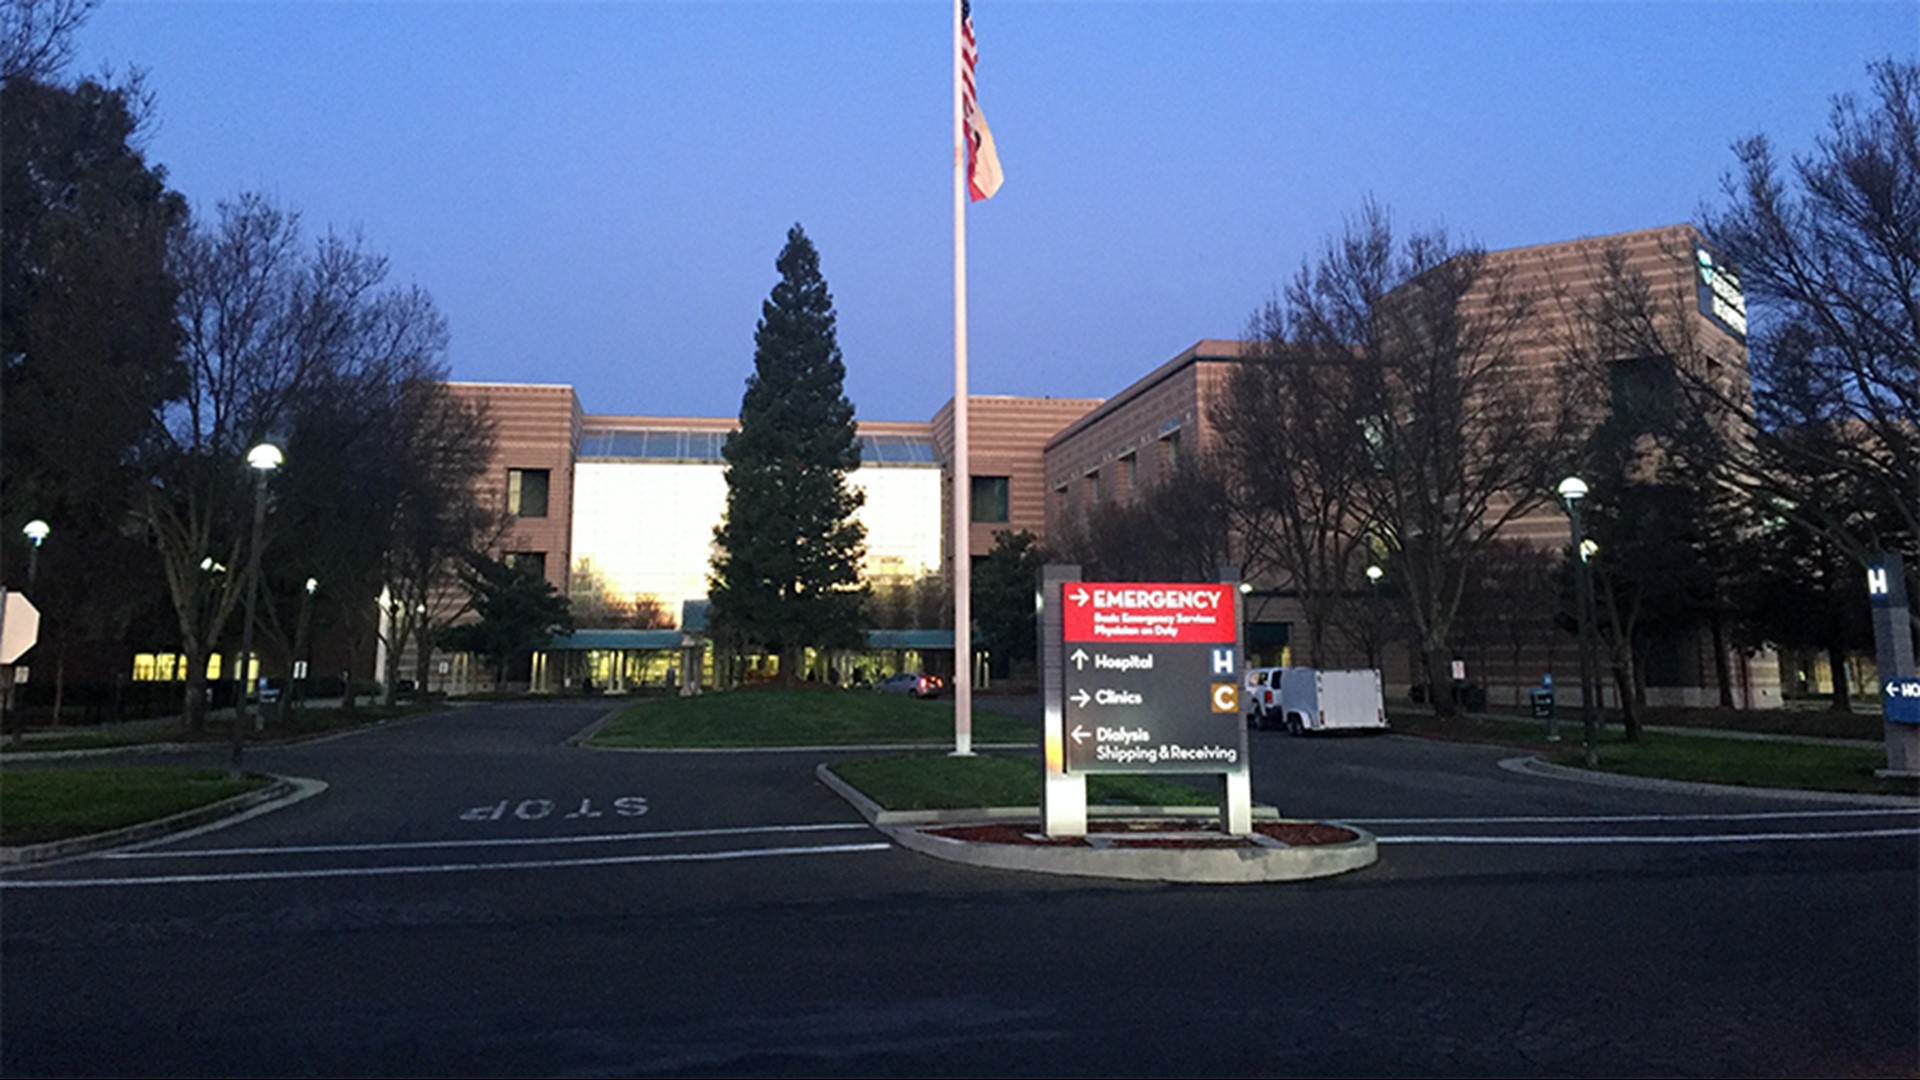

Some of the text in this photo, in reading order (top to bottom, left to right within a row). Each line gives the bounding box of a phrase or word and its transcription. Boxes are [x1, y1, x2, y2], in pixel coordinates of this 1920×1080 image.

[1868, 568, 1888, 594] H
[1093, 590, 1221, 608] EMERGENCY
[1121, 612, 1174, 625] Emergency
[1176, 613, 1216, 624] Services
[1094, 625, 1139, 637] Physician
[1155, 625, 1178, 637] Duty
[1095, 653, 1153, 671] Hospital
[1213, 650, 1234, 674] H
[1095, 689, 1143, 704] Clinics
[1213, 686, 1235, 710] C
[1096, 725, 1150, 745] Dialysis
[1096, 745, 1237, 763] Shipping & Receiving
[459, 797, 649, 820] STOP
